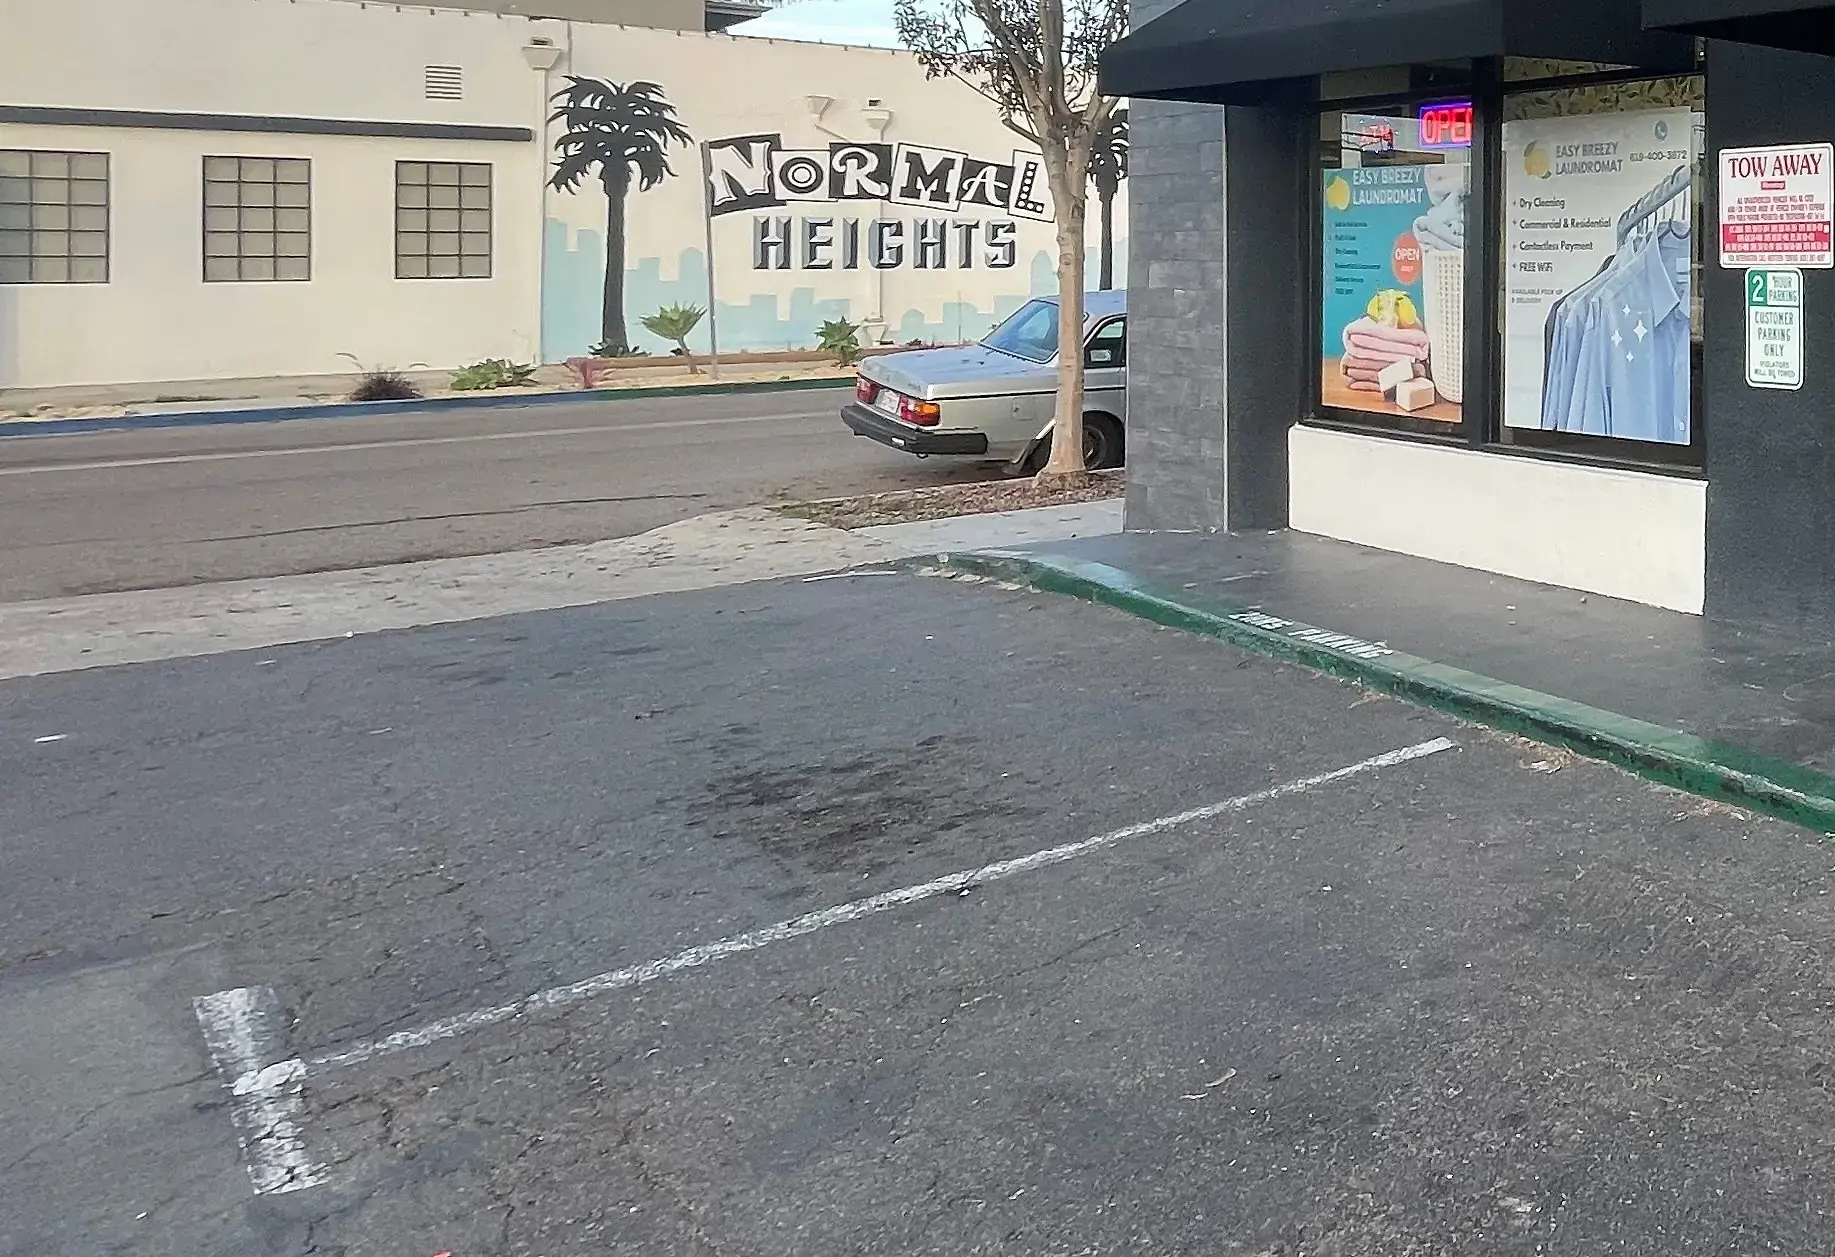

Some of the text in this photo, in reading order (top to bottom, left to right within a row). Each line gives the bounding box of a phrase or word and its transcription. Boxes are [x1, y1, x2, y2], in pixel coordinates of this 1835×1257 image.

[1556, 142, 1619, 158] EASY BREEZY
[1556, 160, 1624, 175] LAUNDROMAT
[1728, 153, 1822, 178] TOW AWAY
[707, 141, 1048, 216] NORMAL
[1352, 167, 1422, 185] EASY BREEZY
[1352, 187, 1424, 205] LAUNDROMAT
[1520, 197, 1565, 210] Dry Cleaning
[1519, 217, 1612, 230] Commercial & Residential
[753, 216, 1017, 271] HEIGHTS
[1519, 240, 1594, 253] Contactless Payment
[1395, 248, 1420, 261] OPEN
[1519, 261, 1536, 272] FREE
[1752, 274, 1764, 302] 2
[1754, 311, 1794, 325] CUSTOMER
[1758, 327, 1791, 342] PARKING
[1764, 344, 1784, 357] ONLY
